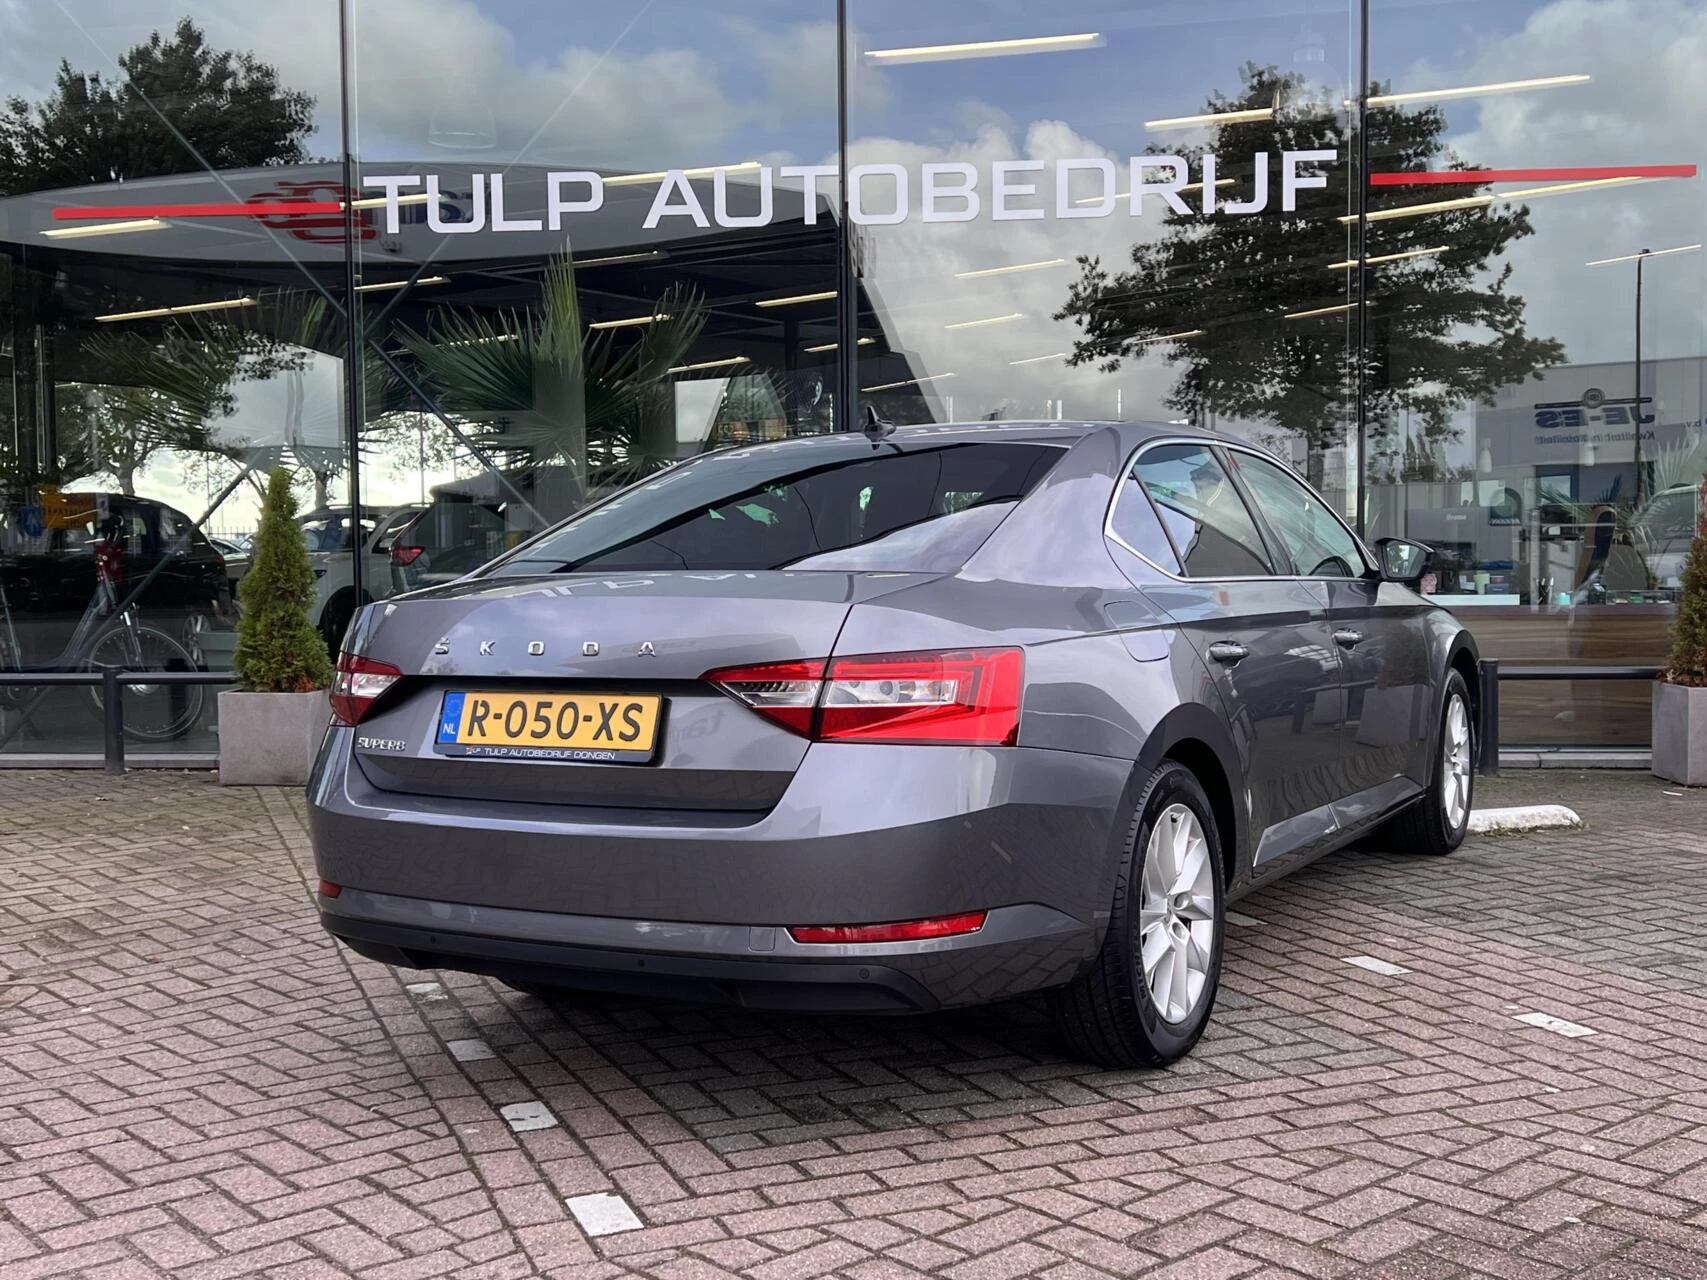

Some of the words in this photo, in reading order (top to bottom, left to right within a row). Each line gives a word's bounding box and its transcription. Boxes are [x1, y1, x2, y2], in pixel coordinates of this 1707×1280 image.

[363, 171, 604, 234] TULP
[642, 149, 1337, 229] AUTOBEDRIJF
[467, 700, 643, 742] R-050-XS
[442, 723, 456, 735] NL
[357, 737, 406, 751] SUPERB
[484, 748, 508, 756] TULP
[509, 748, 571, 759] AUTOBEDRIJF
[574, 751, 616, 760] DONGEN
